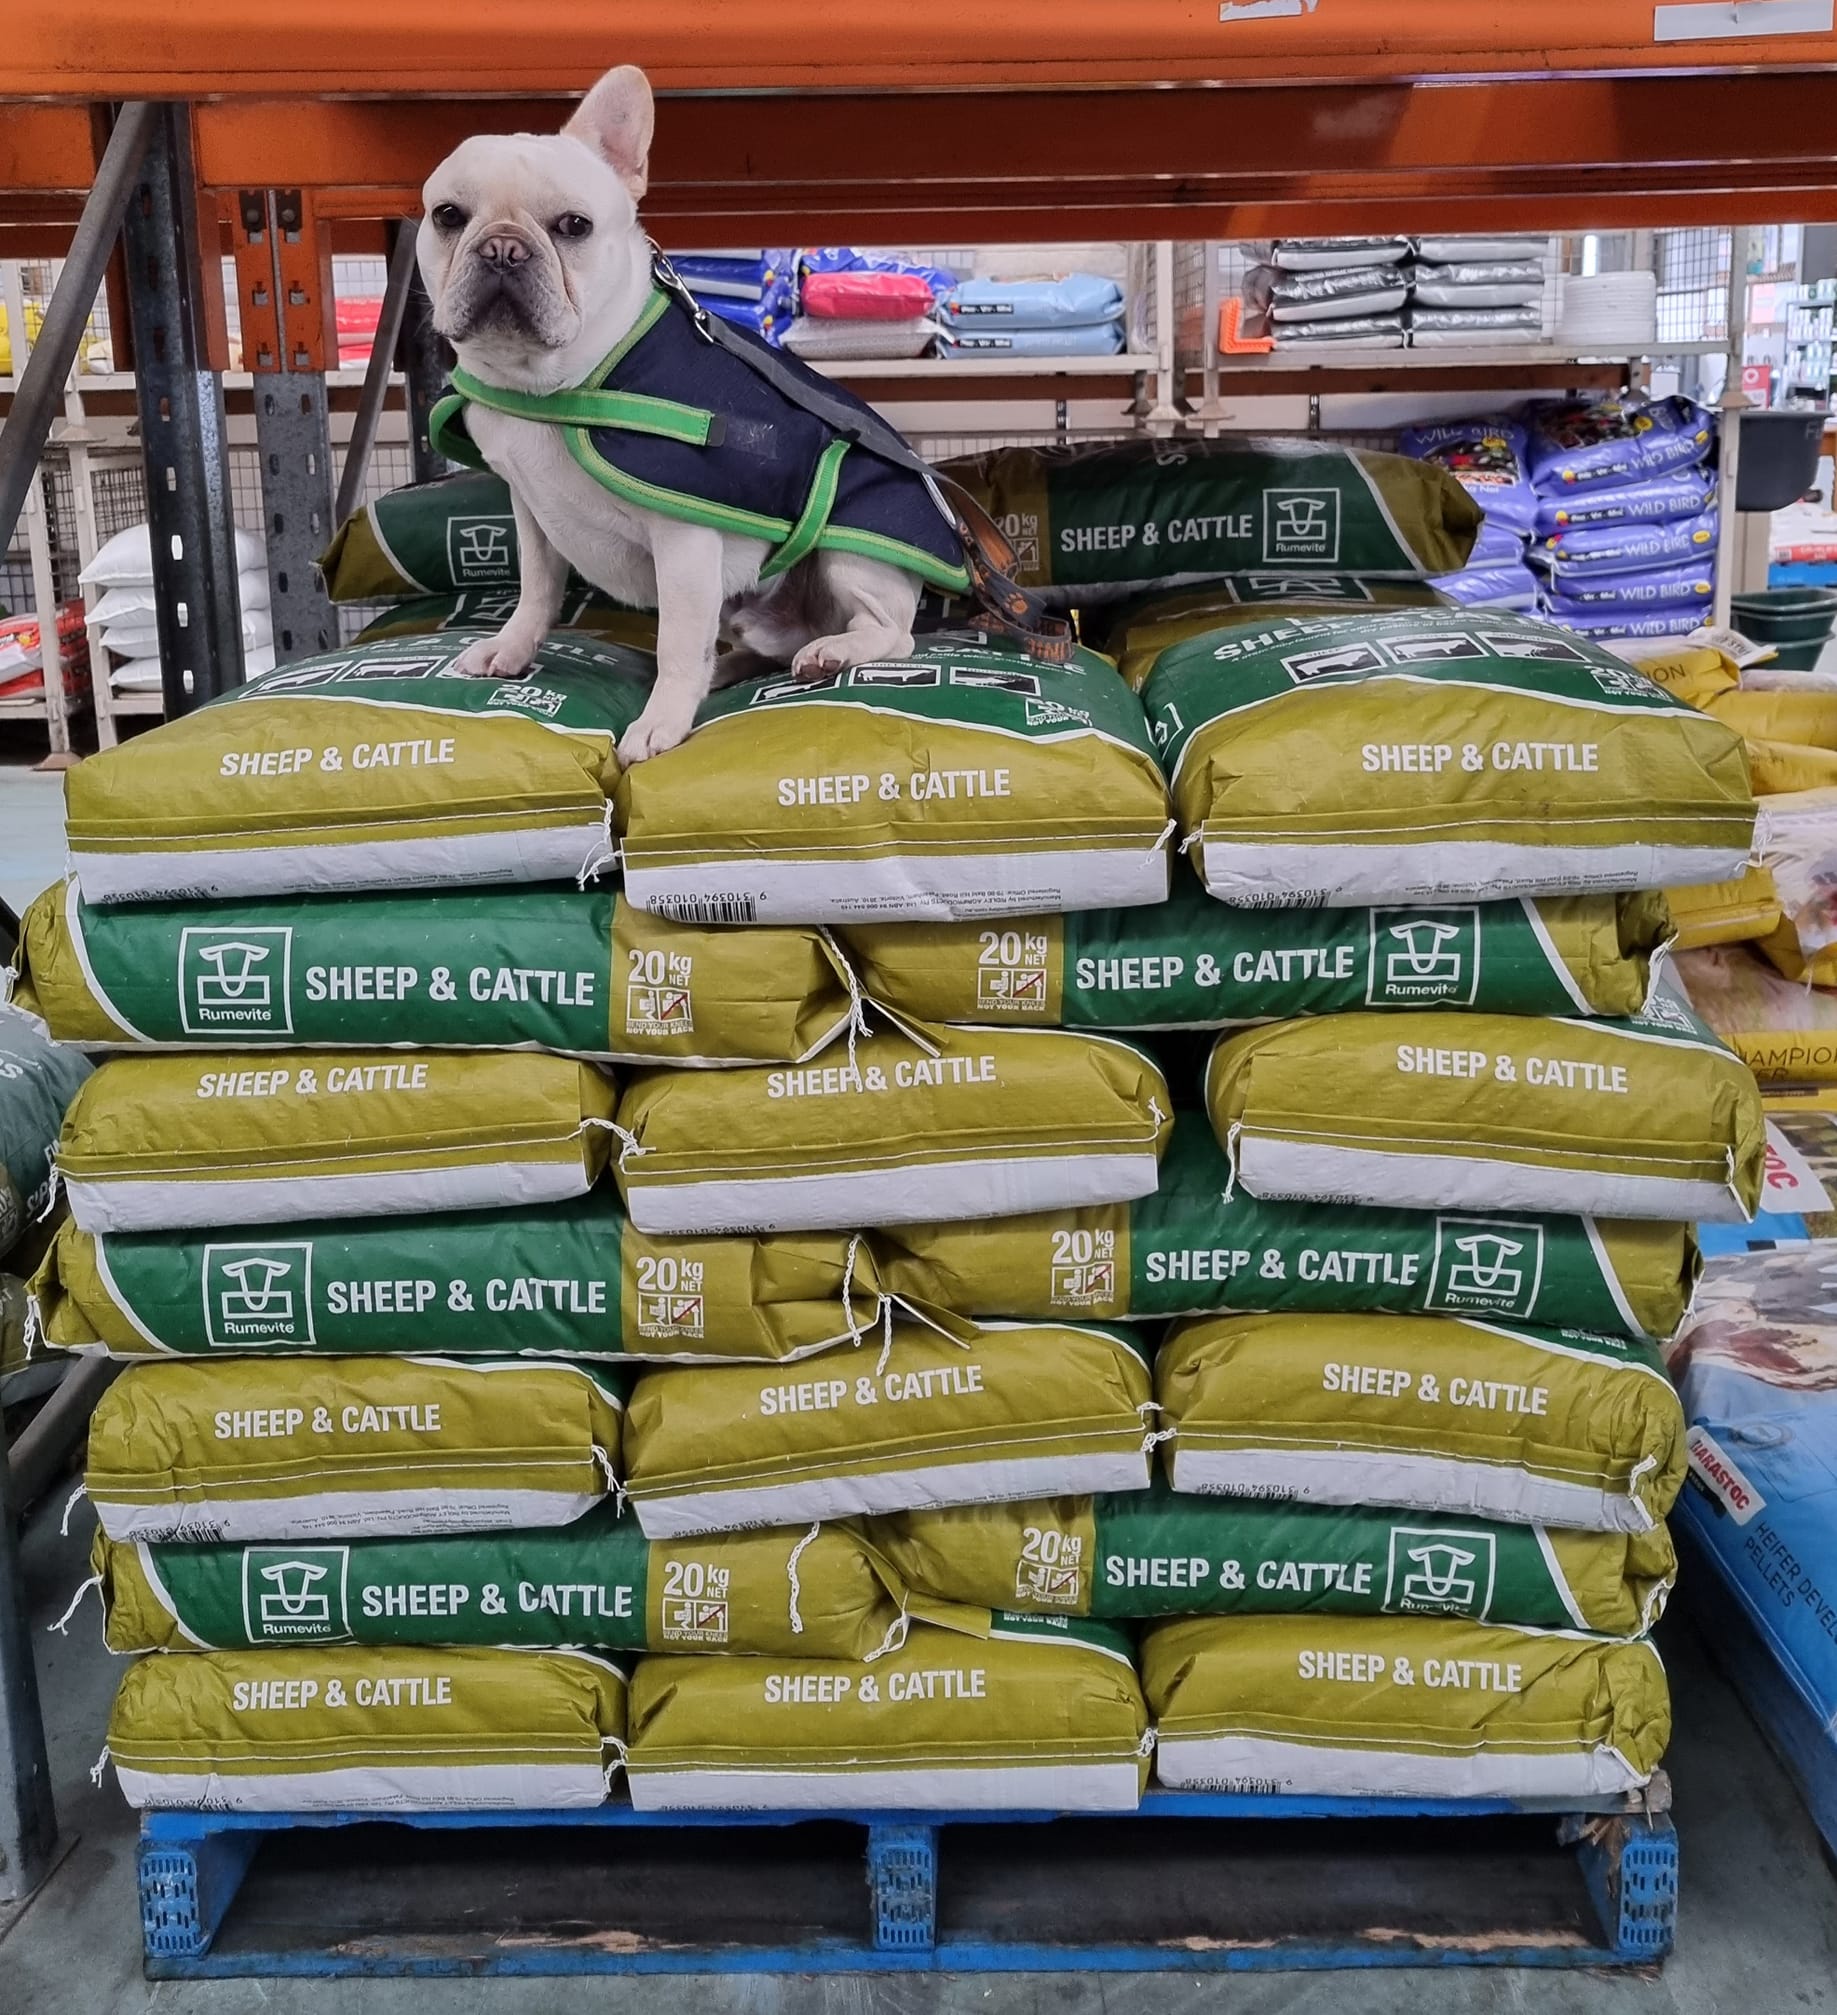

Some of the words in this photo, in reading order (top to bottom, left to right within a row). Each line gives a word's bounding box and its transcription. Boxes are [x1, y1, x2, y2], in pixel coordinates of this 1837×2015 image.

[1630, 452, 1663, 470] WILD
[1667, 439, 1694, 460] BIRD
[1629, 502, 1665, 517] WILD
[1669, 495, 1700, 513] BIRD
[1060, 525, 1136, 552] SHEEP
[1142, 524, 1160, 547] &
[1167, 515, 1253, 544] CATTLE
[1276, 542, 1326, 553] Rumevite
[1624, 539, 1660, 556] WILD
[463, 568, 511, 577] Rumevite
[1621, 585, 1656, 600] WILD
[1660, 584, 1691, 595] BIRD
[1630, 621, 1666, 636] WILD
[1669, 617, 1700, 631] BIRD
[219, 746, 313, 776] SHEEP
[320, 745, 344, 771] &
[351, 738, 456, 768] CATTLE
[1362, 744, 1452, 773] SHEEP
[1461, 744, 1485, 772] &
[1492, 742, 1599, 772] CATTLE
[777, 775, 870, 806] SHEEP
[878, 773, 901, 799] &
[909, 768, 1011, 800] CATTLE
[649, 894, 697, 905] 010358
[704, 893, 752, 903] 310394
[979, 931, 1022, 966] 20
[1025, 932, 1047, 954] kg
[1025, 954, 1047, 966] NET
[628, 949, 665, 985] 20
[669, 952, 692, 975] kg
[669, 974, 690, 986] NET
[1076, 957, 1183, 991] SHEEP
[1194, 954, 1221, 987] &
[1233, 945, 1355, 982] CATTLE
[305, 966, 418, 1001] SHEEP
[428, 966, 456, 1001] &
[469, 967, 595, 1006] CATTLE
[199, 1007, 272, 1022] Rumevite
[197, 1070, 289, 1098] SHEEP
[295, 1068, 317, 1094] &
[327, 1064, 429, 1092] CATTLE
[767, 1067, 857, 1099] SHEEP
[864, 1066, 888, 1091] &
[895, 1056, 996, 1088] CATTLE
[1397, 1045, 1487, 1079] SHEEP
[1494, 1056, 1517, 1082] &
[1525, 1057, 1629, 1094] CATTLE
[1052, 1230, 1092, 1264] 20
[1095, 1228, 1114, 1248] kg
[1094, 1248, 1114, 1258] NET
[636, 1256, 677, 1292] 20
[681, 1258, 704, 1280] kg
[1146, 1251, 1250, 1283] SHEEP
[1259, 1249, 1286, 1279] &
[1298, 1250, 1419, 1286] CATTLE
[327, 1280, 437, 1314] SHEEP
[447, 1279, 476, 1312] &
[486, 1278, 606, 1313] CATTLE
[681, 1280, 702, 1292] NET
[1445, 1293, 1516, 1308] Rumevite
[224, 1321, 296, 1335] Rumevite
[760, 1380, 847, 1416] SHEEP
[855, 1376, 878, 1406] &
[884, 1365, 984, 1402] CATTLE
[1322, 1363, 1412, 1398] SHEEP
[1417, 1373, 1440, 1402] &
[1449, 1377, 1549, 1417] CATTLE
[214, 1409, 303, 1439] SHEEP
[311, 1407, 334, 1433] &
[342, 1404, 441, 1433] CATTLE
[1022, 1528, 1061, 1563] 20
[1062, 1535, 1082, 1554] kg
[1061, 1554, 1080, 1566] NET
[1755, 1522, 1801, 1582] HEIFER
[664, 1561, 704, 1597] 20
[708, 1564, 730, 1588] kg
[1106, 1555, 1209, 1588] SHEEP
[1219, 1559, 1245, 1591] &
[1256, 1560, 1373, 1596] CATTLE
[1744, 1535, 1796, 1608] PELLETS
[362, 1584, 469, 1617] SHEEP
[480, 1585, 508, 1614] &
[518, 1581, 633, 1618] CATTLE
[707, 1586, 728, 1598] NET
[264, 1623, 332, 1636] Rumevite
[764, 1675, 851, 1704] SHEEP
[858, 1674, 881, 1701] &
[889, 1669, 986, 1701] CATTLE
[1299, 1651, 1385, 1683] SHEEP
[1392, 1657, 1416, 1687] &
[1423, 1660, 1522, 1694] CATTLE
[233, 1680, 318, 1711] SHEEP
[325, 1679, 348, 1706] &
[355, 1677, 452, 1706] CATTLE
